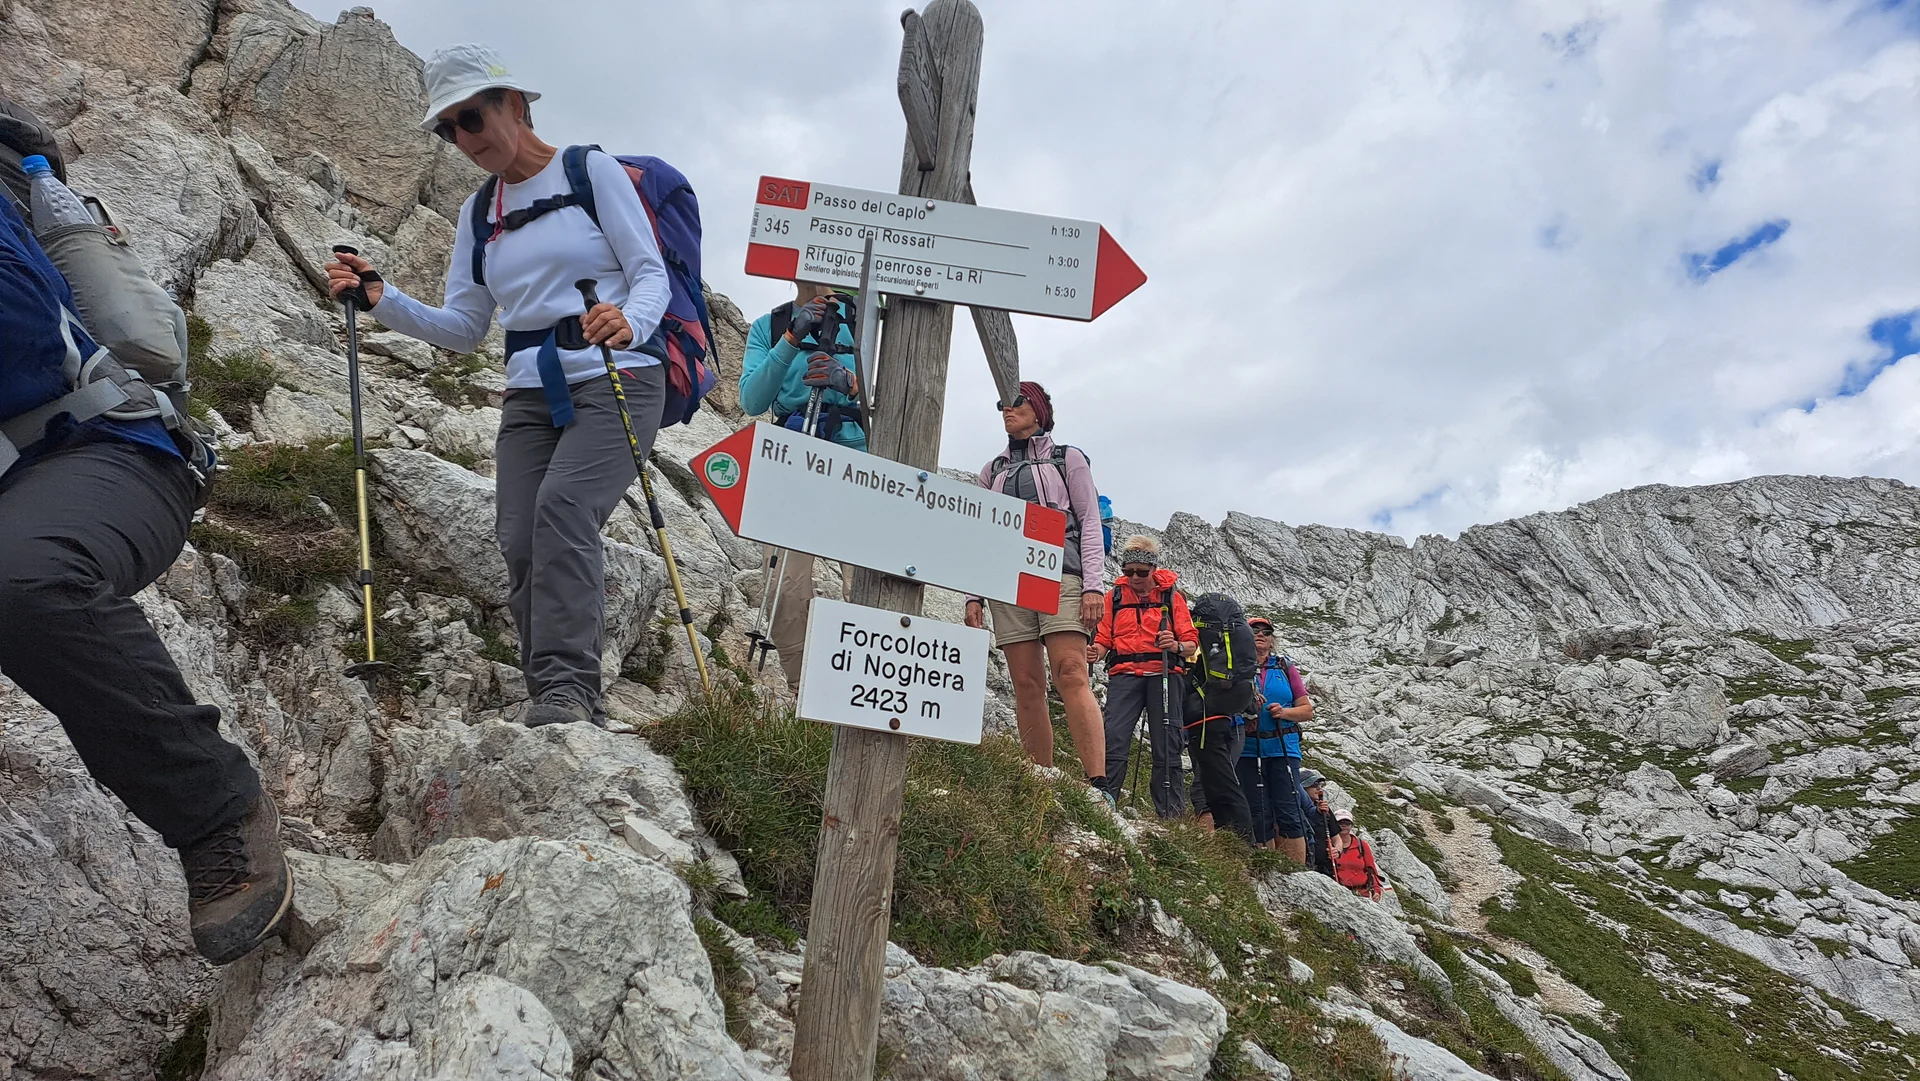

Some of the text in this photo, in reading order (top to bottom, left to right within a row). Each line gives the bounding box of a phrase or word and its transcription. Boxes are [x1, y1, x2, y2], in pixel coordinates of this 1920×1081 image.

[764, 182, 804, 204] SAT
[814, 192, 926, 221] Passo del Caplo
[764, 218, 790, 235] 345
[810, 218, 936, 249] Passo dei Rossati
[1051, 225, 1081, 239] h 1:30
[804, 262, 830, 275] Sentiero
[805, 246, 856, 267] Rifugio
[862, 258, 932, 278] penrose
[946, 266, 964, 282] La
[968, 270, 983, 284] Ri
[1048, 254, 1080, 269] h 3:00
[1045, 284, 1077, 299] h 5:30
[606, 362, 626, 400] LEKI
[720, 472, 736, 483] Trek
[760, 438, 792, 466] Rif.
[806, 450, 833, 477] Val
[842, 463, 982, 520] Ambiez-Agostini
[991, 507, 1022, 531] 1.00
[1026, 546, 1057, 571] 320
[839, 622, 961, 665] Forcolotta
[830, 648, 964, 692] di Noghera
[850, 684, 941, 720] 2423 m
